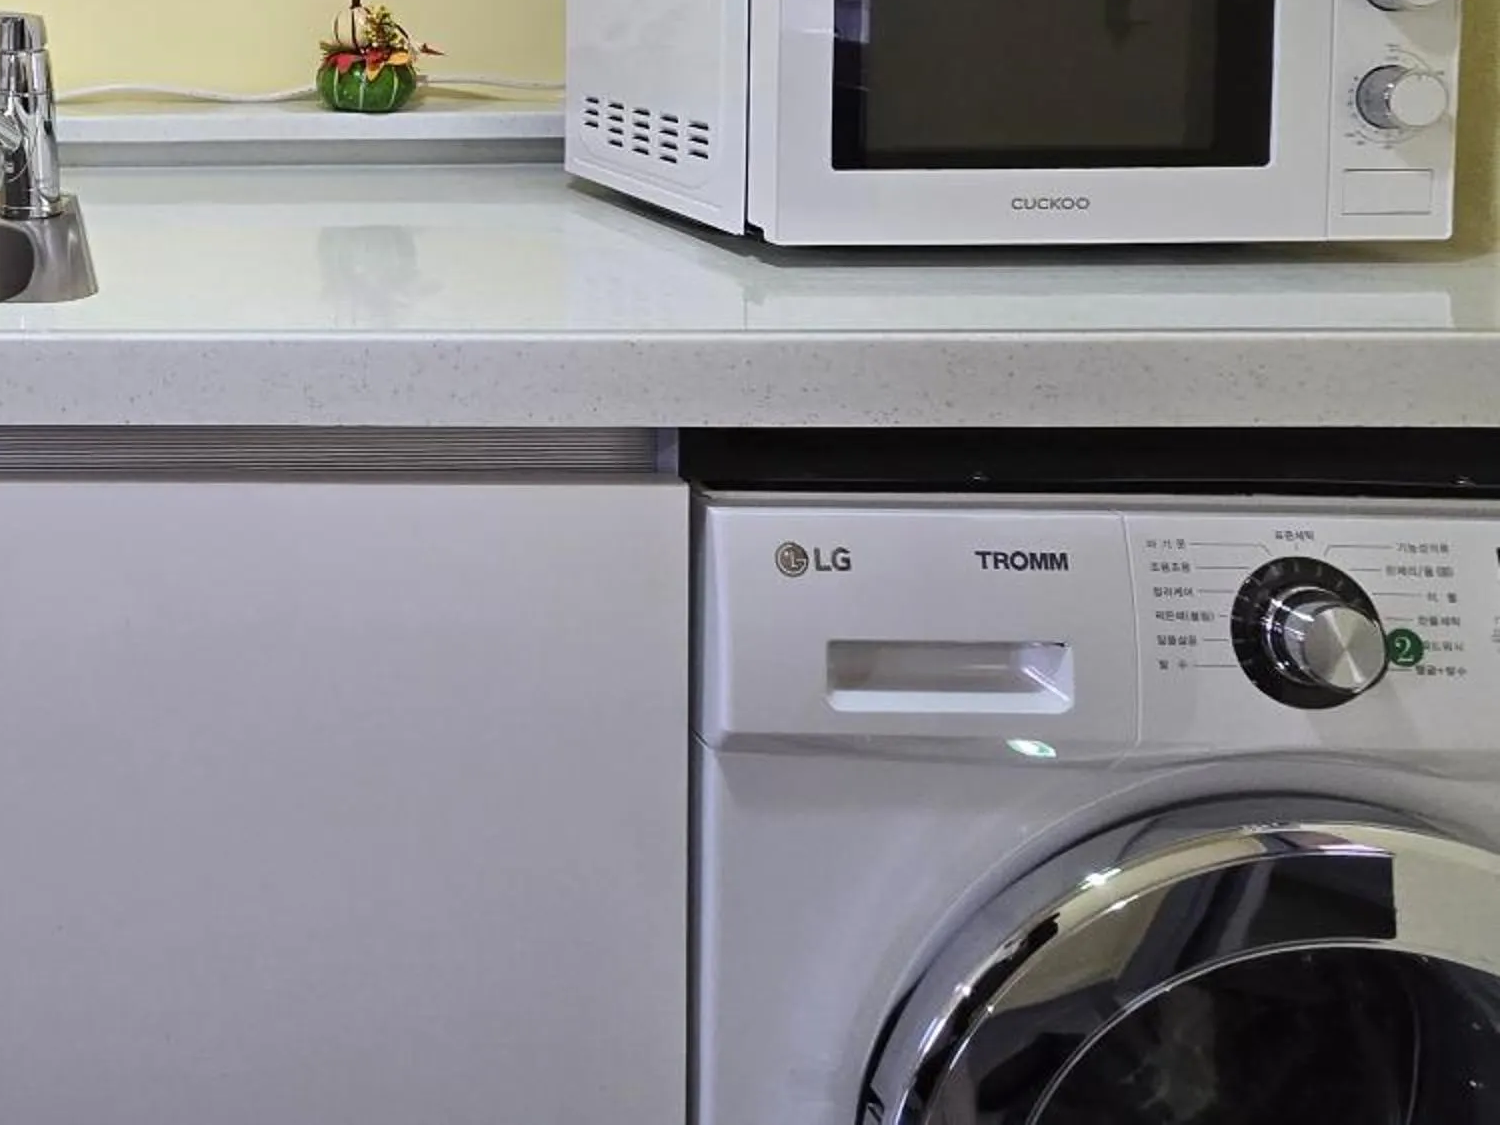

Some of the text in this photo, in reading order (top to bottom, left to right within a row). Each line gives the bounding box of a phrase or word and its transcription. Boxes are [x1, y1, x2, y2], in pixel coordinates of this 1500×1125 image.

[1011, 197, 1091, 210] CUCKOO
[974, 551, 1069, 572] TROMM
[1394, 636, 1414, 663] 2
